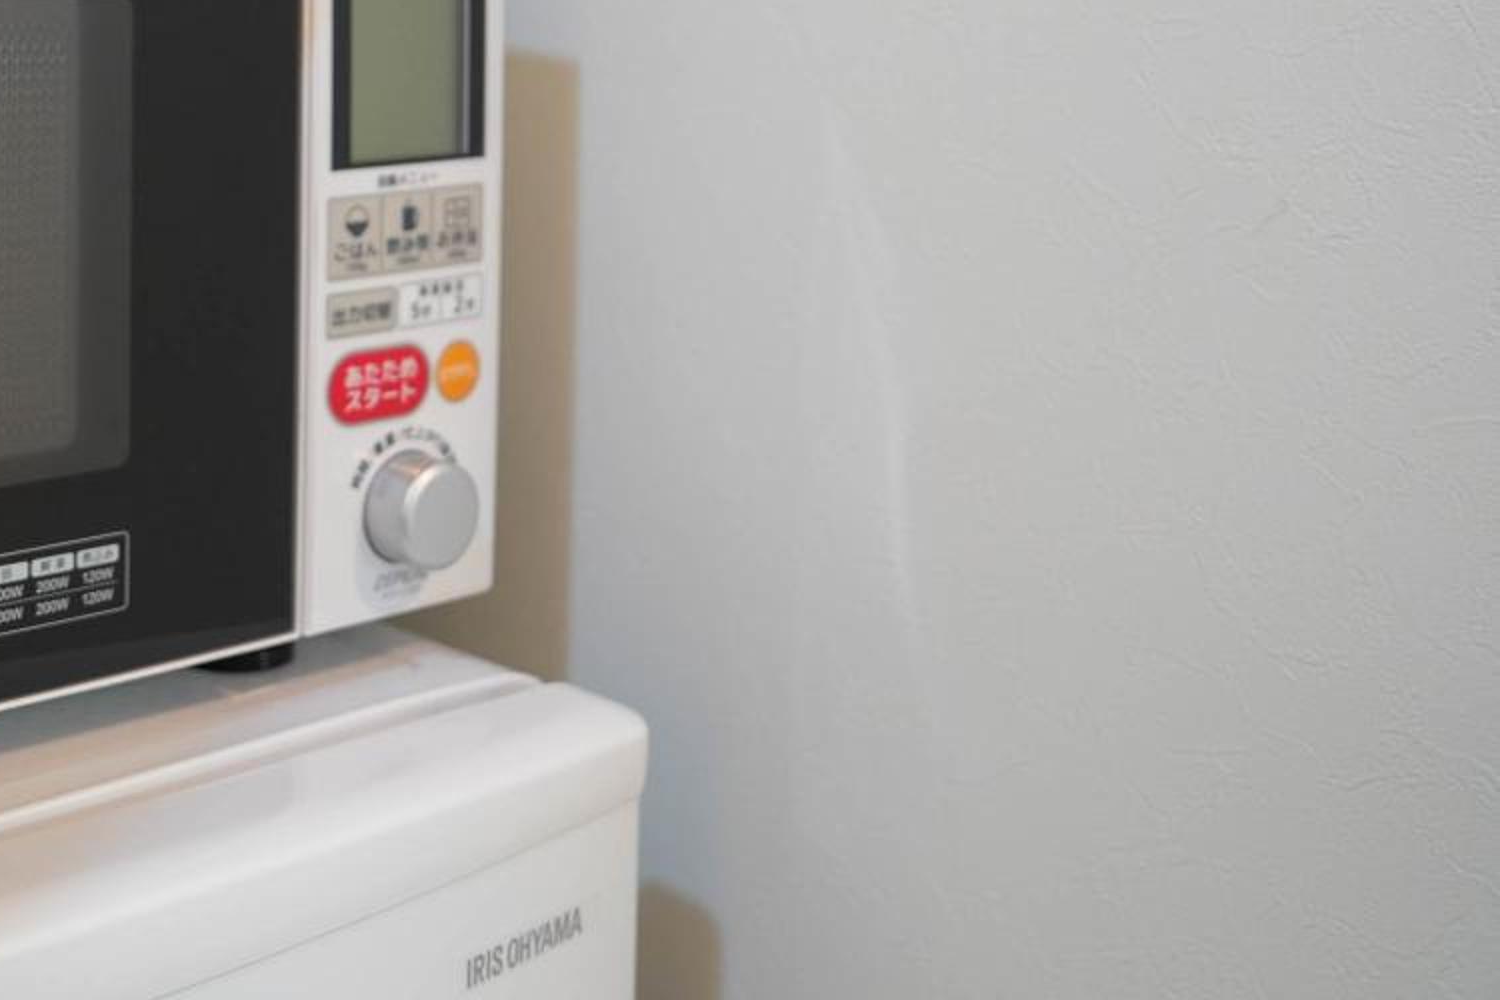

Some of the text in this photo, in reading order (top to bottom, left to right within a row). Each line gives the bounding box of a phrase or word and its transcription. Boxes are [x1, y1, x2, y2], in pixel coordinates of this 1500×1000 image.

[343, 355, 420, 389] あたため
[343, 379, 417, 415] スタート
[465, 906, 584, 990] IRIS OHYAMA
